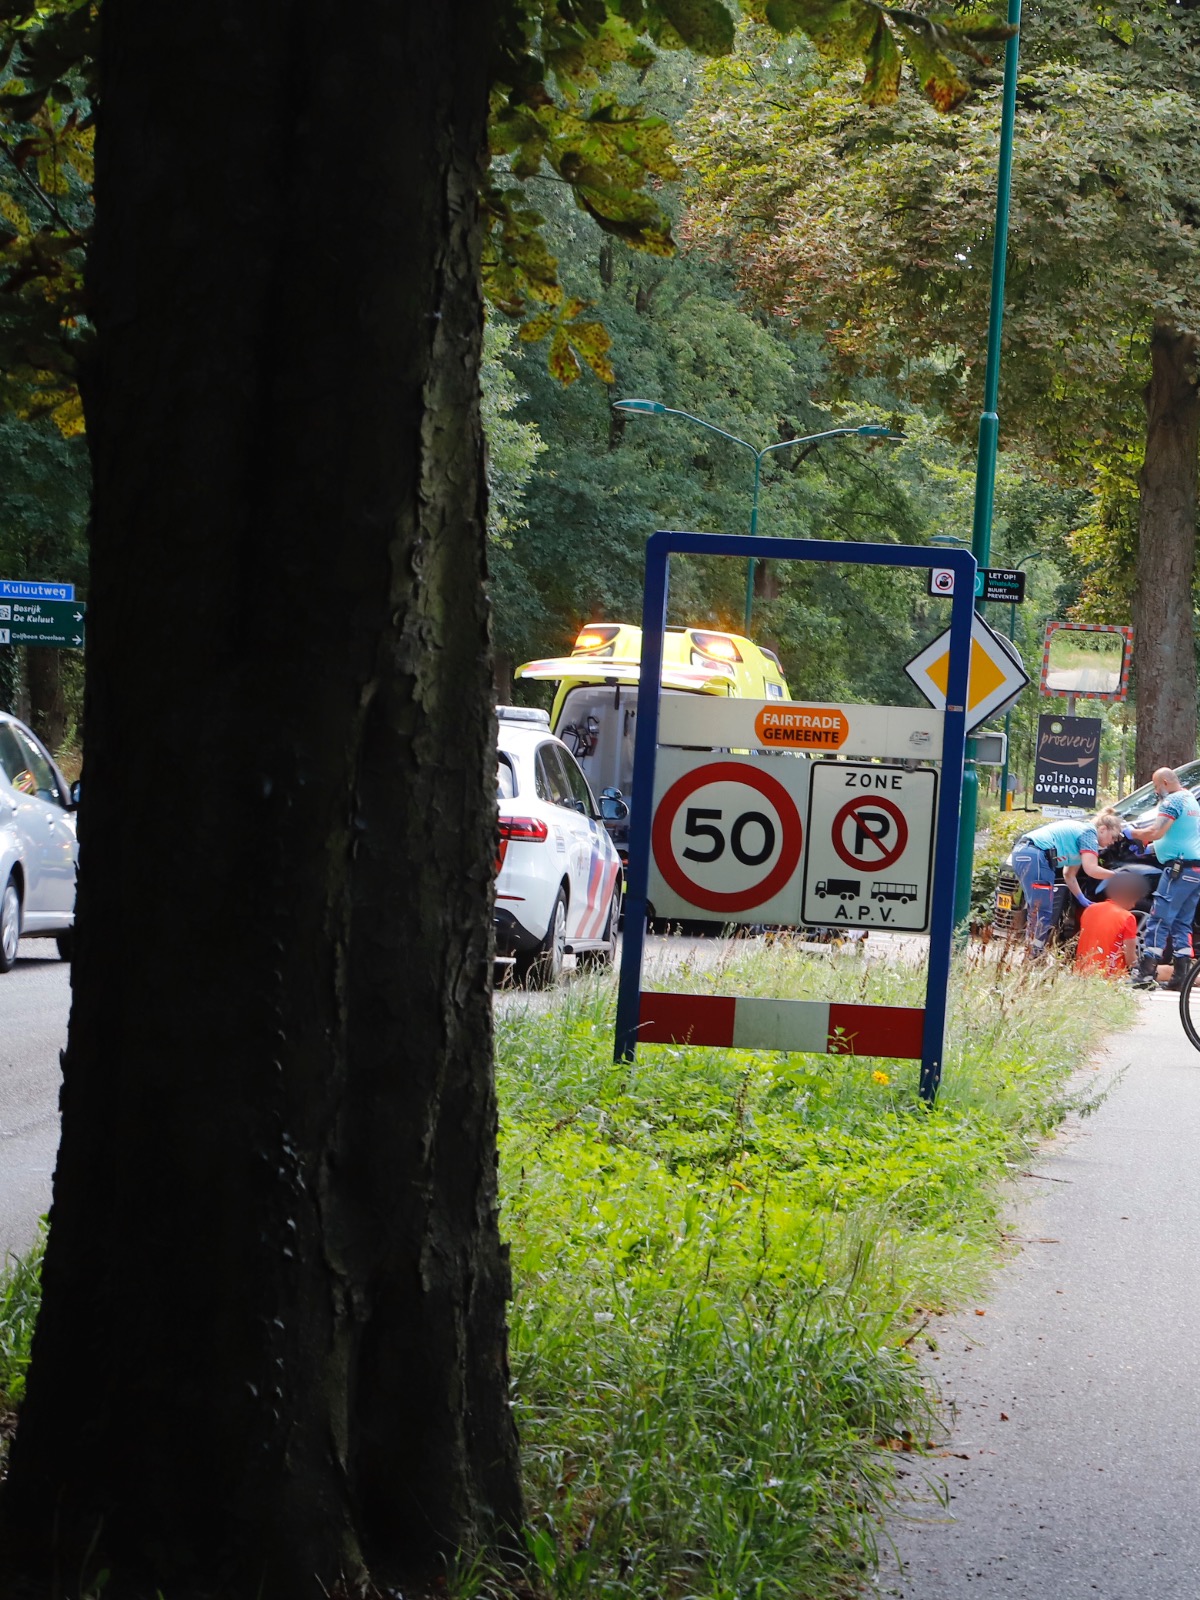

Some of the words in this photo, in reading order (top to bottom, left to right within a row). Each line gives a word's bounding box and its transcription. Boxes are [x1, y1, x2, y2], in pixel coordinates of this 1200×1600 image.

[3, 583, 66, 599] Kuluutweg
[989, 580, 1019, 588] WhatsApp
[987, 592, 1019, 600] PREVENTIE
[13, 604, 41, 615] Bosrijk
[13, 614, 25, 622] De
[27, 615, 54, 624] Kuluut
[762, 713, 841, 729] FAIRTRADE
[763, 728, 839, 743] GEMEENTE
[1038, 732, 1097, 754] proeverij
[845, 772, 902, 790] ZONE
[1039, 771, 1093, 785] golfbaan
[1035, 784, 1095, 797] overloon
[682, 808, 775, 867] 50
[854, 811, 891, 855] P
